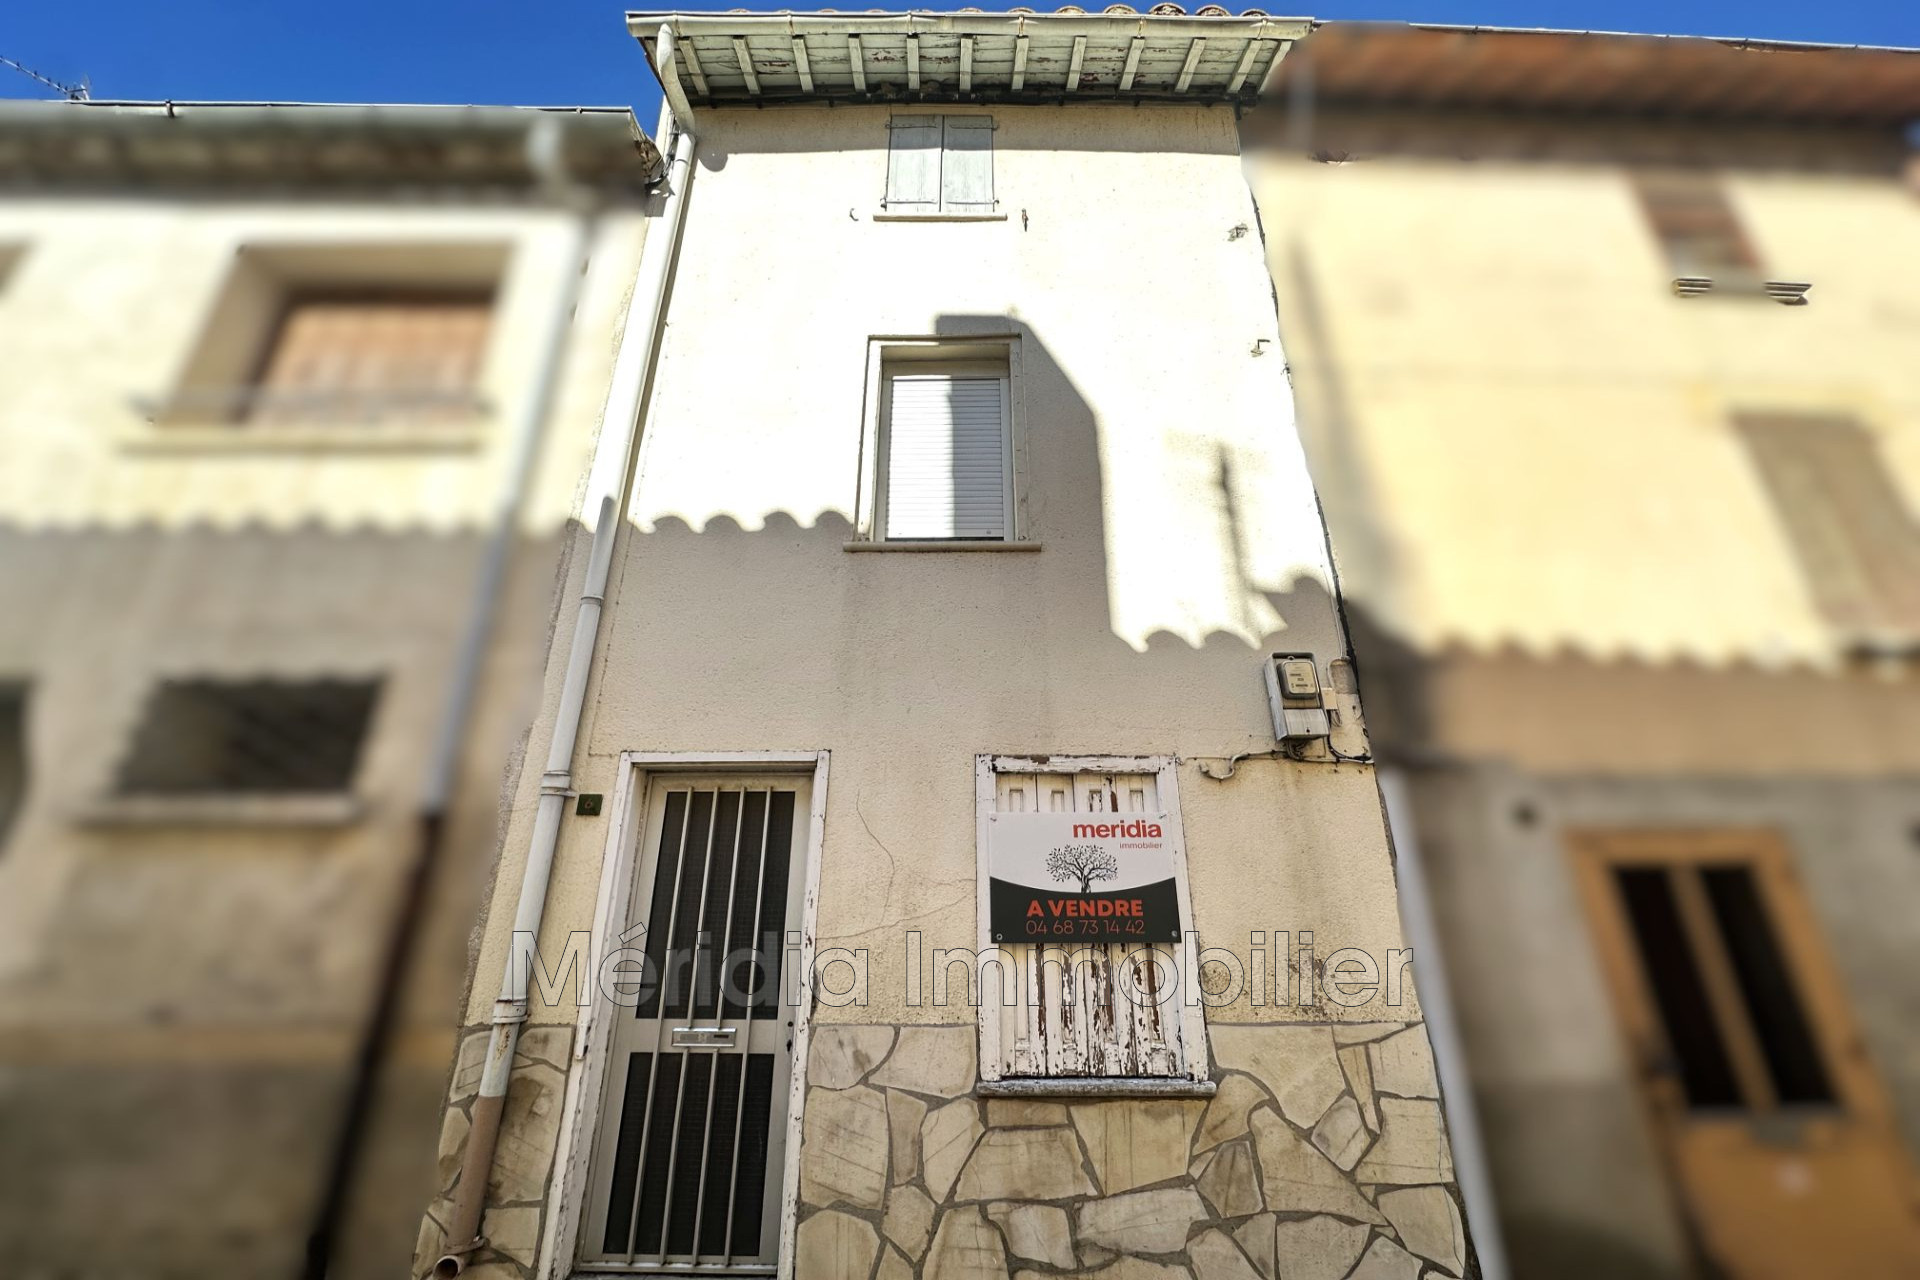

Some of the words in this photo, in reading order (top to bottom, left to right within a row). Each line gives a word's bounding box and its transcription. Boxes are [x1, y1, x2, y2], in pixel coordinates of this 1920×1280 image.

[1073, 820, 1162, 838] meridia
[1026, 899, 1044, 917] A
[1048, 899, 1144, 917] VENDRE
[1026, 919, 1048, 935] 04
[1053, 919, 1074, 935] 68
[1079, 919, 1099, 935] 73
[1103, 919, 1120, 935] 14
[1125, 919, 1146, 935] 42
